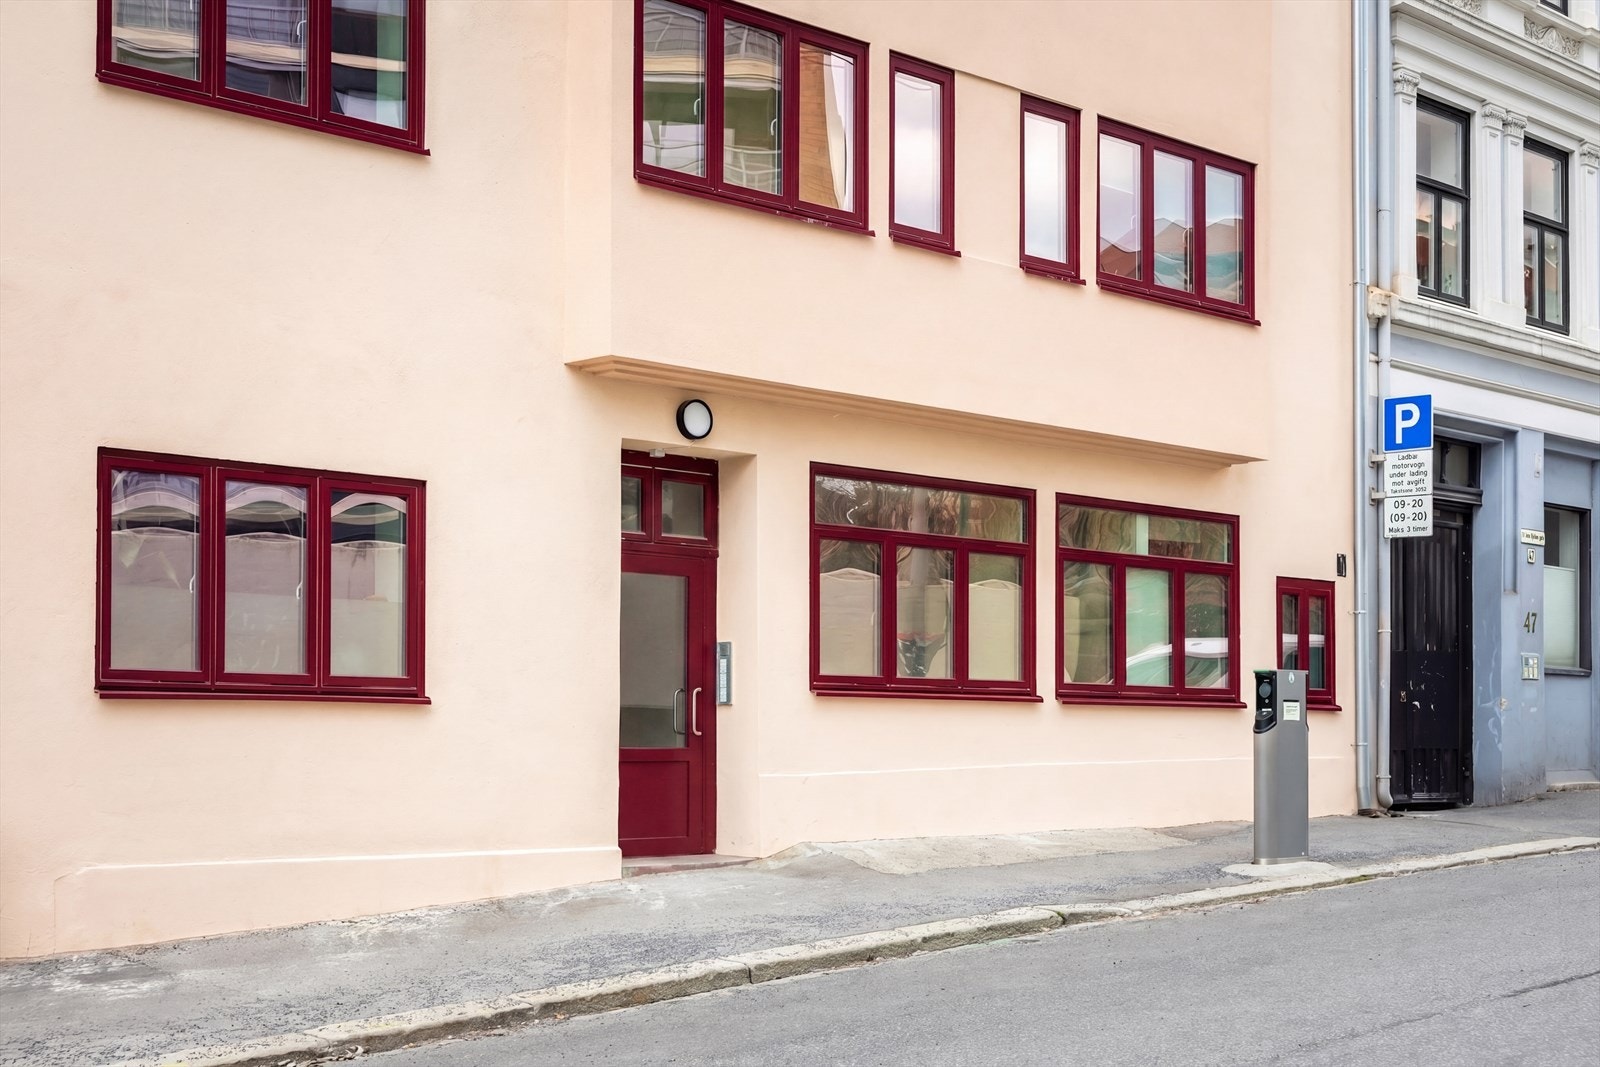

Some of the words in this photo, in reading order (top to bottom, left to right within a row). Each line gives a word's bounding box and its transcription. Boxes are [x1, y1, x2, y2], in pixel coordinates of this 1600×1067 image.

[1395, 402, 1420, 444] P
[1391, 462, 1425, 470] motorvogn
[1389, 471, 1406, 479] under
[1410, 470, 1428, 478] lading
[1406, 477, 1425, 486] avgift
[1393, 499, 1423, 509] 09-20
[1390, 511, 1427, 523] (09-20)
[1523, 612, 1537, 633] 47
